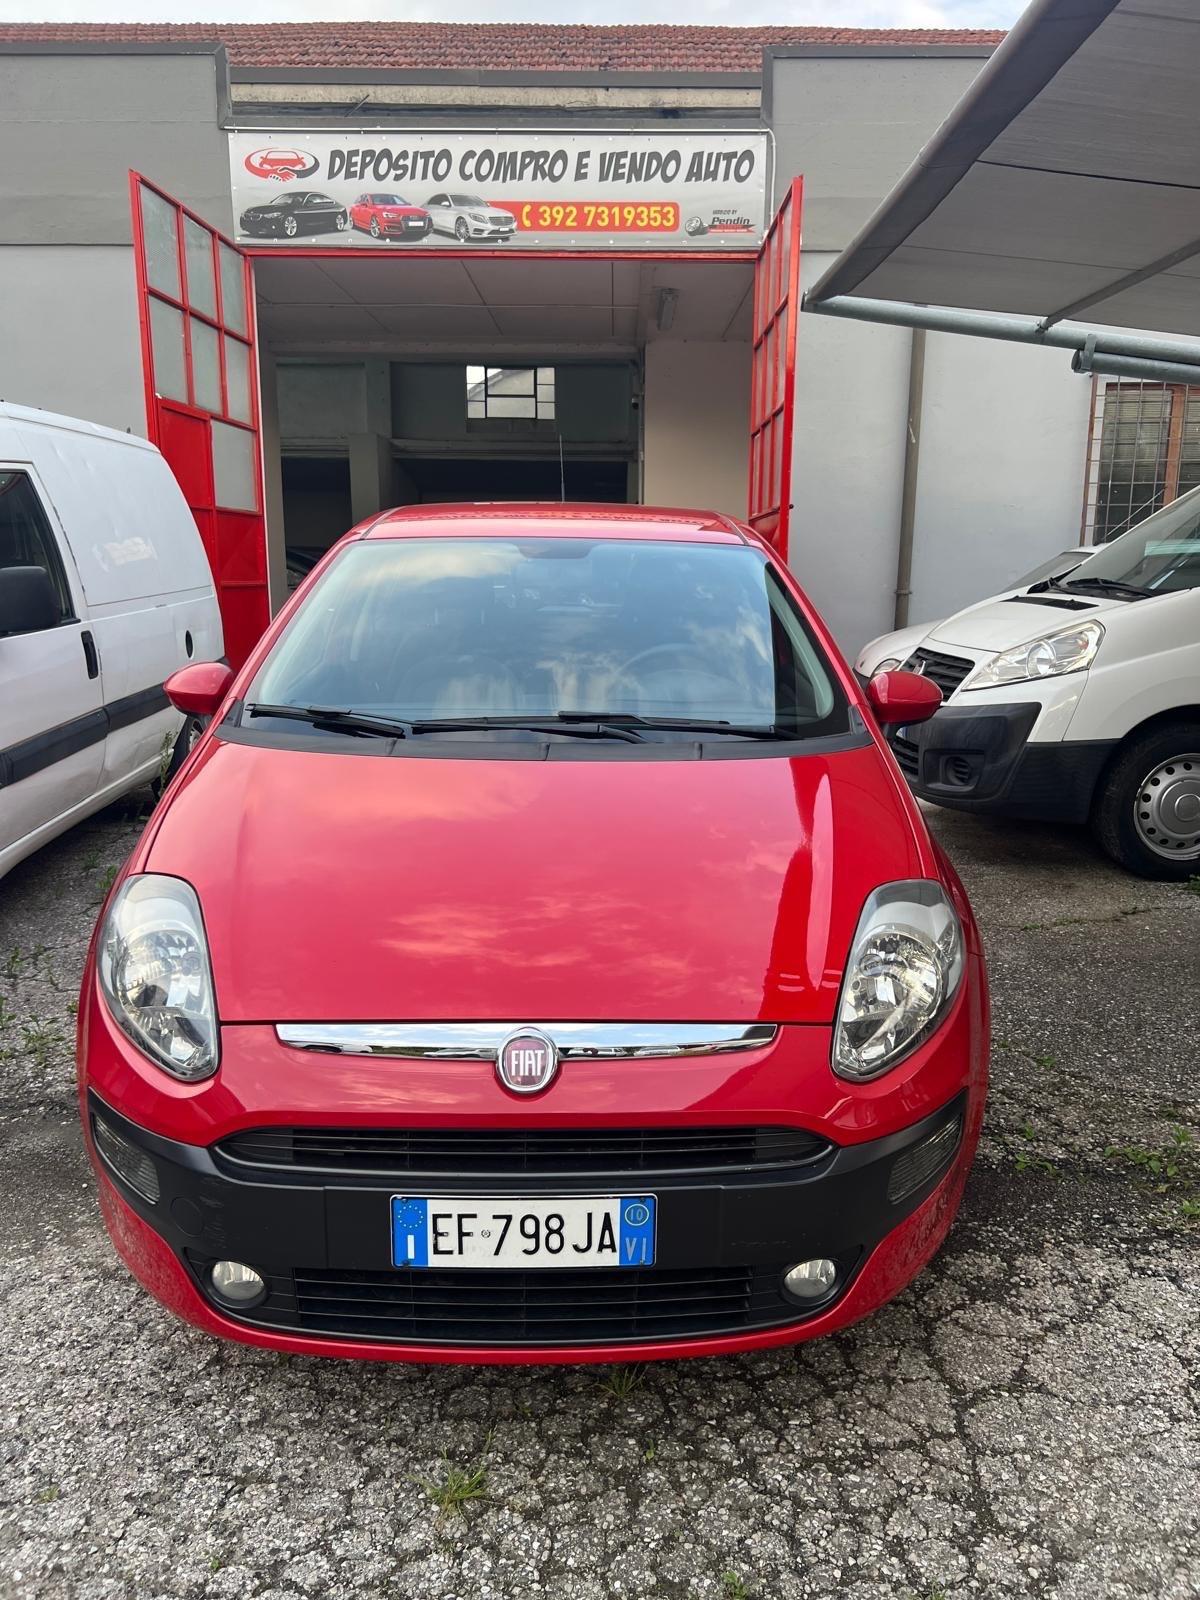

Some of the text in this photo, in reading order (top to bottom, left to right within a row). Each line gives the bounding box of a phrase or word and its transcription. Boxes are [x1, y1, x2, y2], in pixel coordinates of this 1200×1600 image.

[327, 148, 755, 184] DEPOSITO COMPRO E VENDO AUTO
[538, 206, 675, 227] 392 7319353
[712, 216, 750, 225] Pendin
[511, 1049, 545, 1077] FIAT
[629, 1209, 644, 1221] 10
[431, 1212, 618, 1256] EF 798 JA
[625, 1237, 647, 1262] VI
